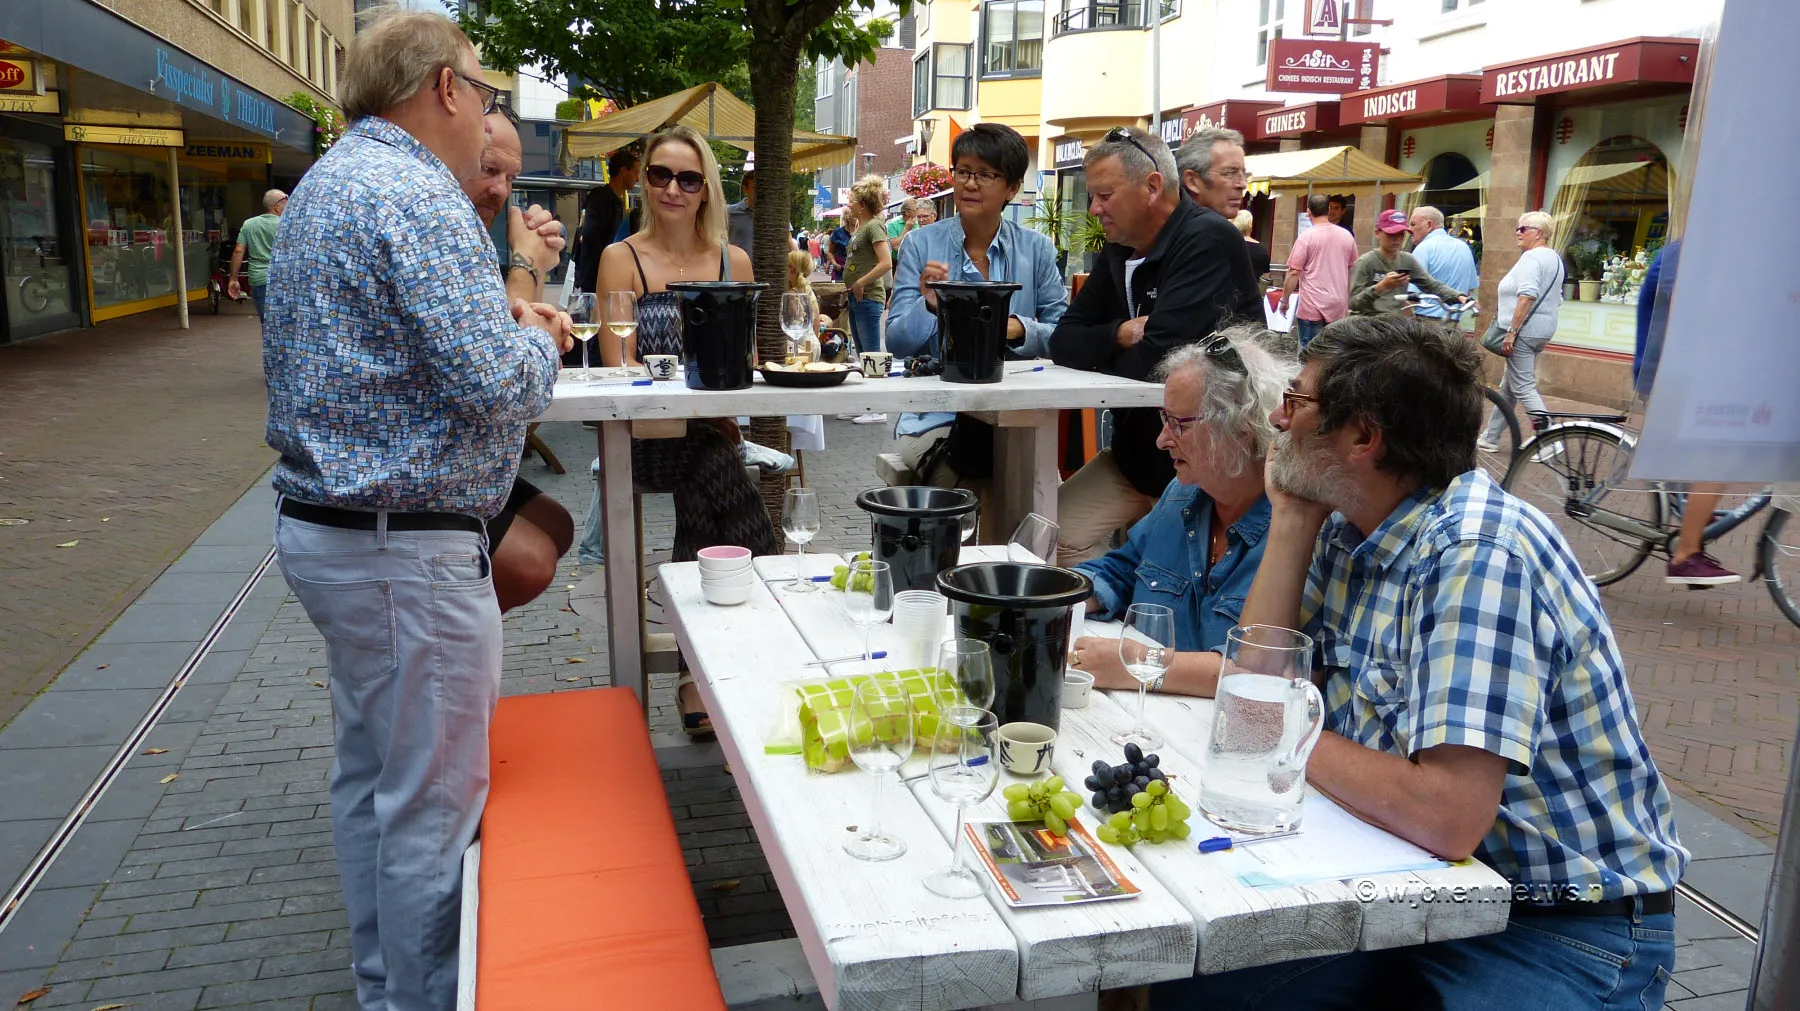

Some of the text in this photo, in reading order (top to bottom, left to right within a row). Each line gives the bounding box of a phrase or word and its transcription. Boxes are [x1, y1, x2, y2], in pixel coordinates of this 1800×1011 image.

[1278, 74, 1355, 85] CHINEES INDISCH RESTAURANT
[1495, 52, 1620, 97] RESTAURANT
[236, 88, 259, 127] THEO
[260, 100, 275, 133] TAX
[1363, 89, 1416, 118] INDISCH
[1265, 111, 1306, 135] CHINEES
[117, 135, 146, 145] THEO
[186, 144, 256, 159] ZEEMAN
